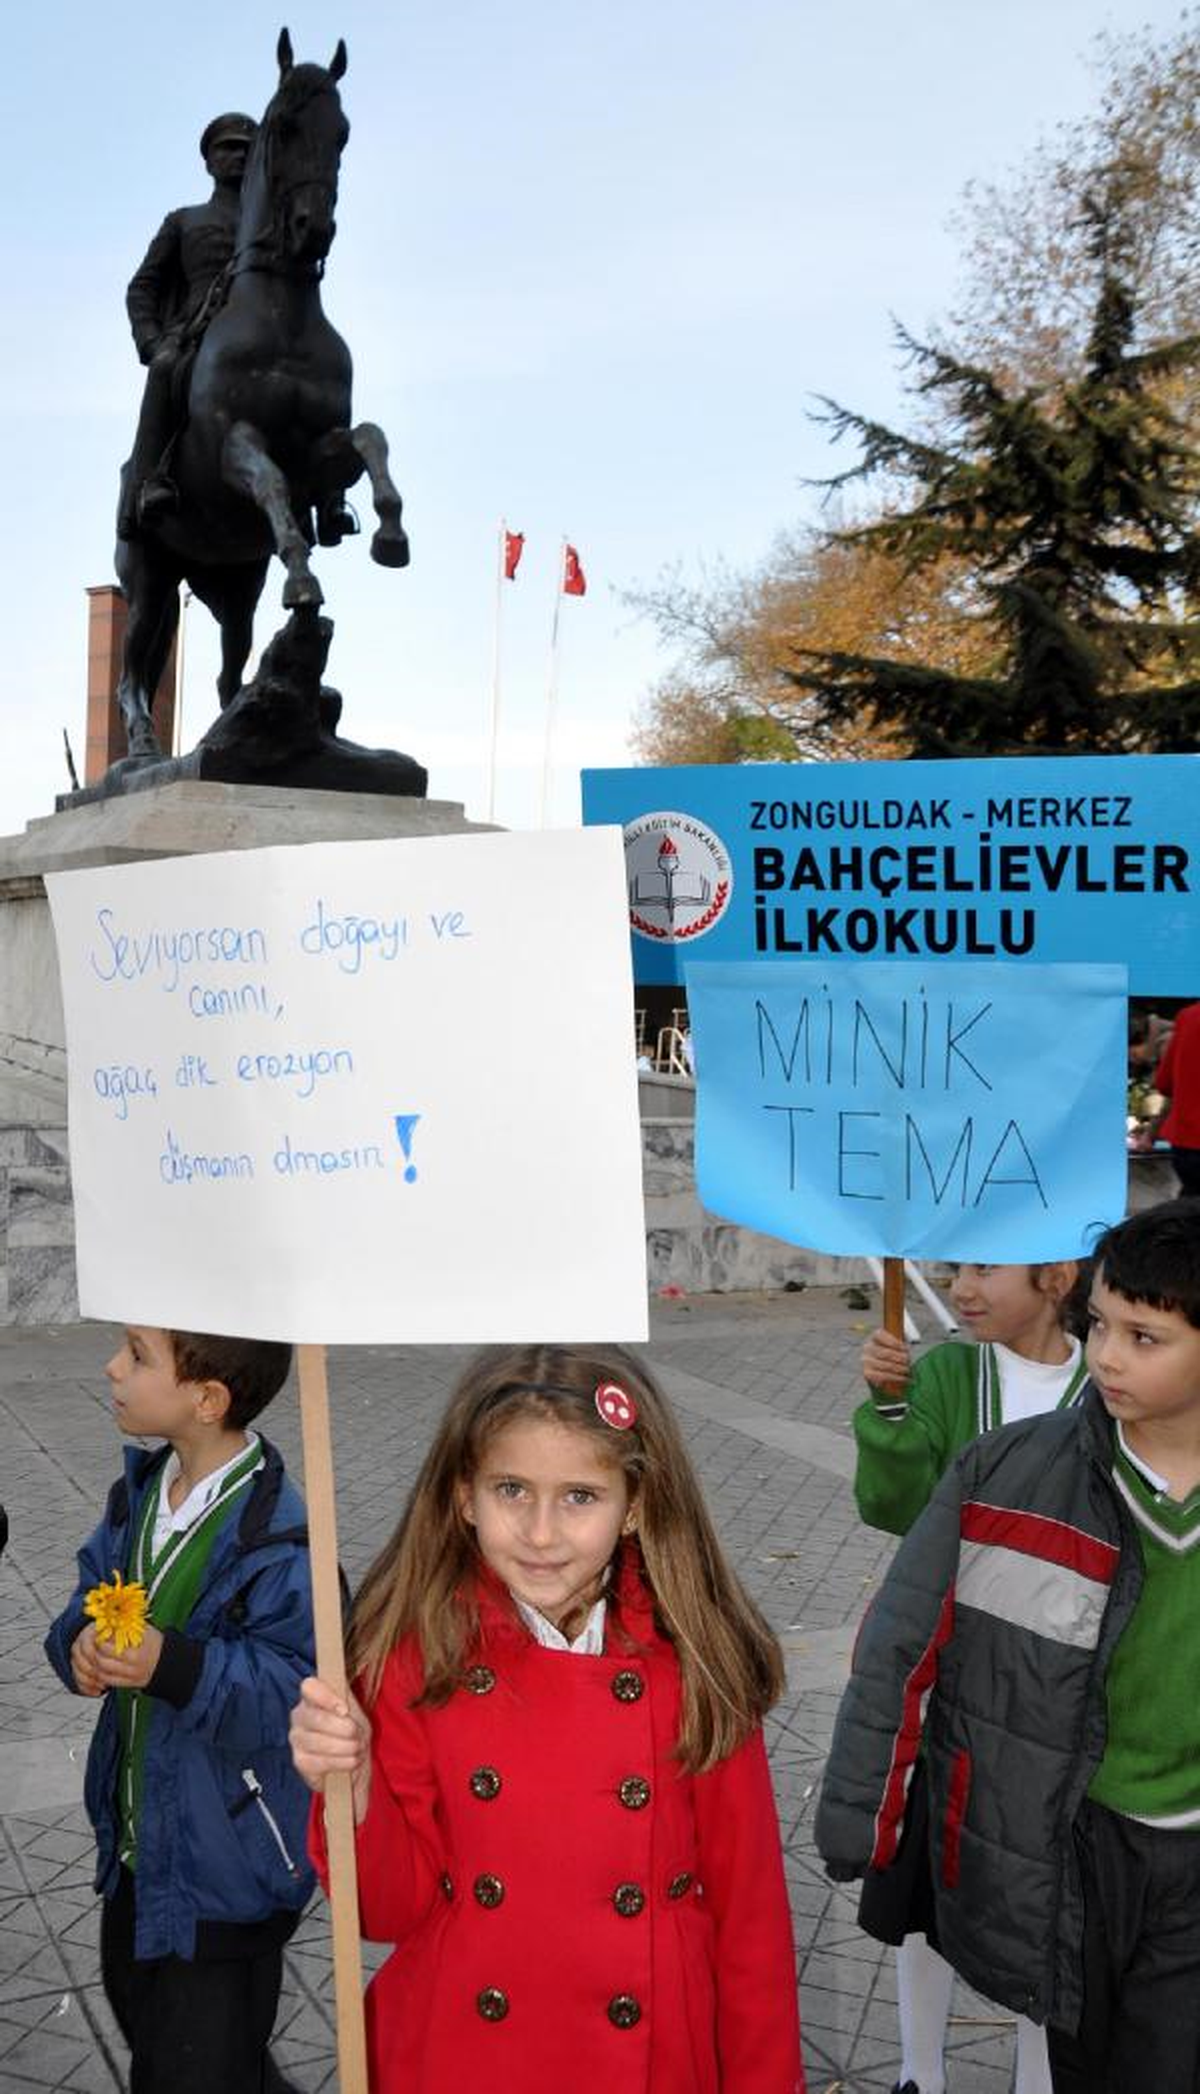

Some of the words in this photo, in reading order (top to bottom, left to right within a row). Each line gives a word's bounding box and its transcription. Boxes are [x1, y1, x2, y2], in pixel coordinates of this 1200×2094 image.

[749, 799, 952, 831] ZONGULDAK
[987, 796, 1133, 829] MERKEZ
[753, 832, 1190, 897] BAHÇELİEVLER
[299, 899, 409, 975] doğayı
[430, 911, 472, 939] ve
[754, 896, 1036, 956] İLKOKULU
[755, 983, 993, 1092] MİNİK
[93, 1064, 159, 1121] ağaç
[175, 1053, 218, 1087] dik
[236, 1049, 354, 1099] erozyon
[762, 1105, 1050, 1210] TEMA
